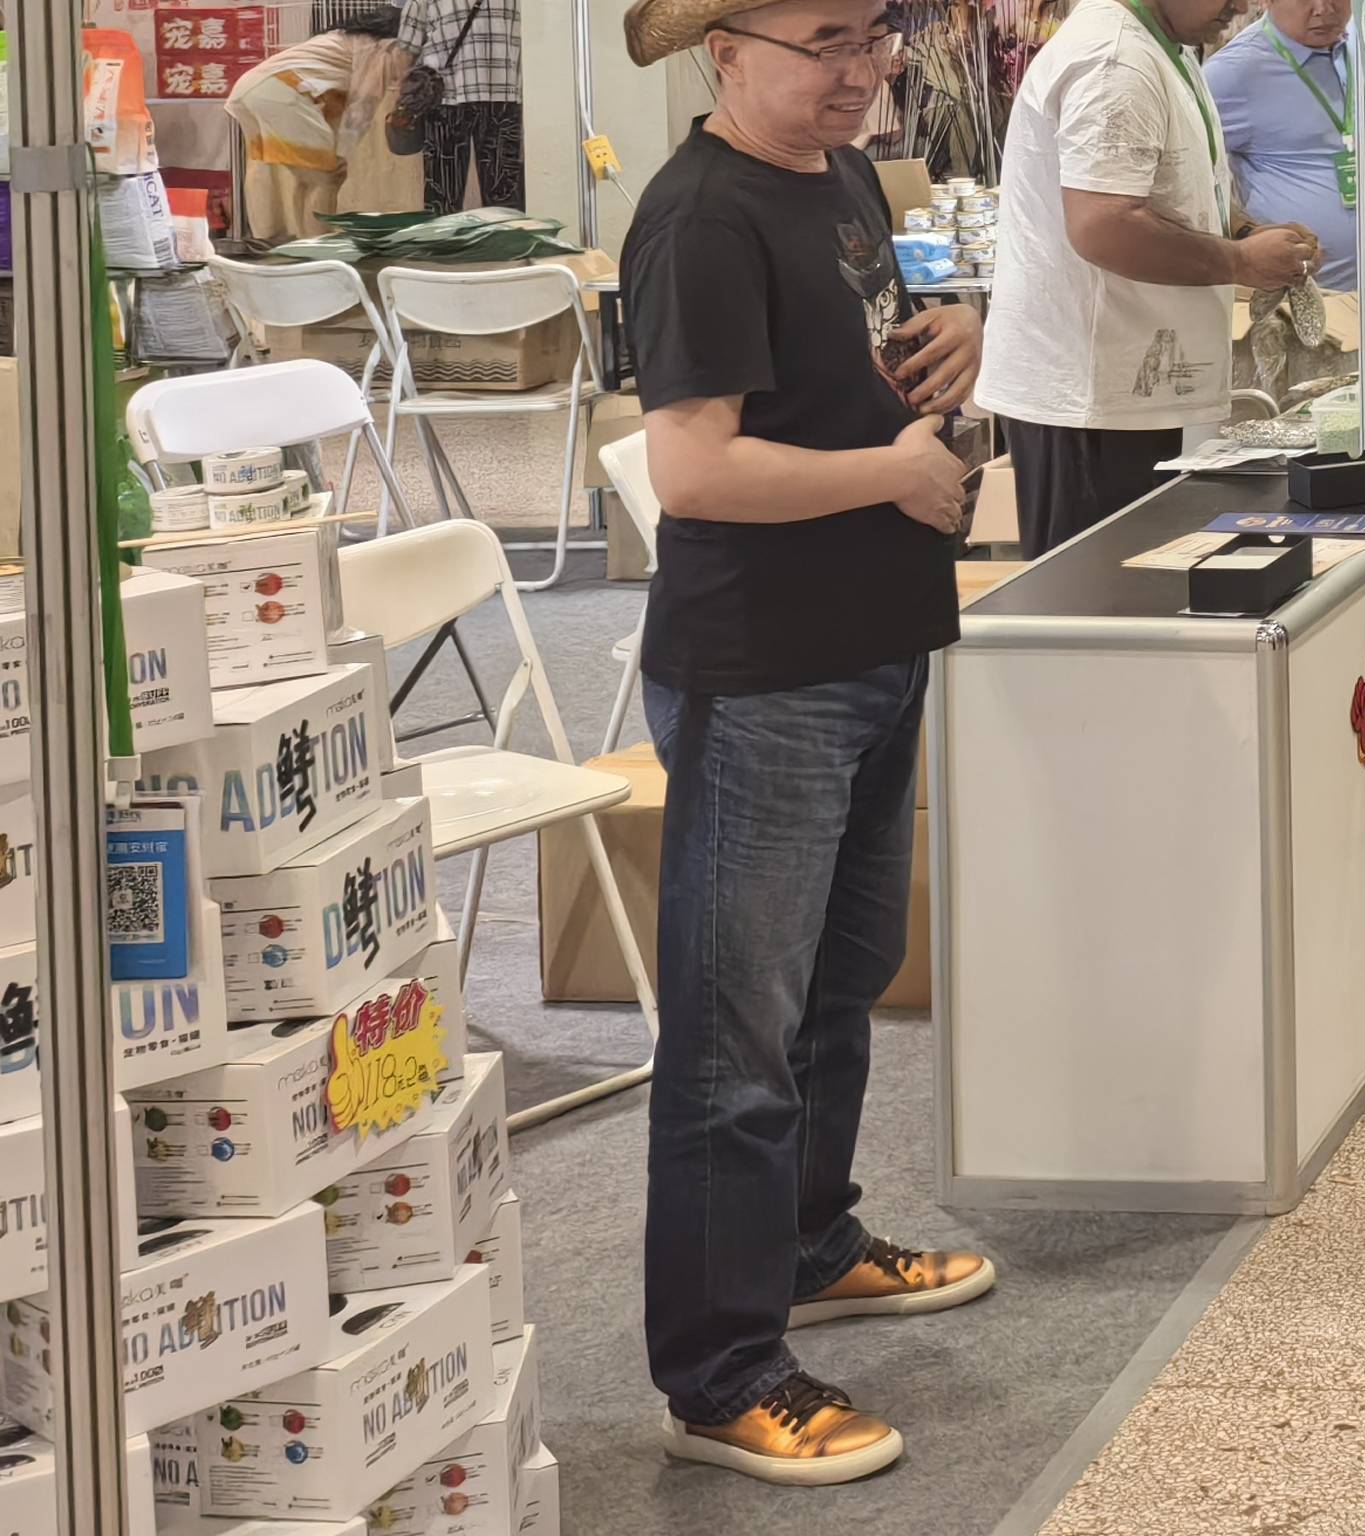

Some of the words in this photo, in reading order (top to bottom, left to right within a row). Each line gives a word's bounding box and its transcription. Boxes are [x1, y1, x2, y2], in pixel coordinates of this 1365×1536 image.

[163, 17, 228, 50] 宠嘉
[164, 62, 229, 95] 宠嘉
[352, 977, 429, 1056] 特价
